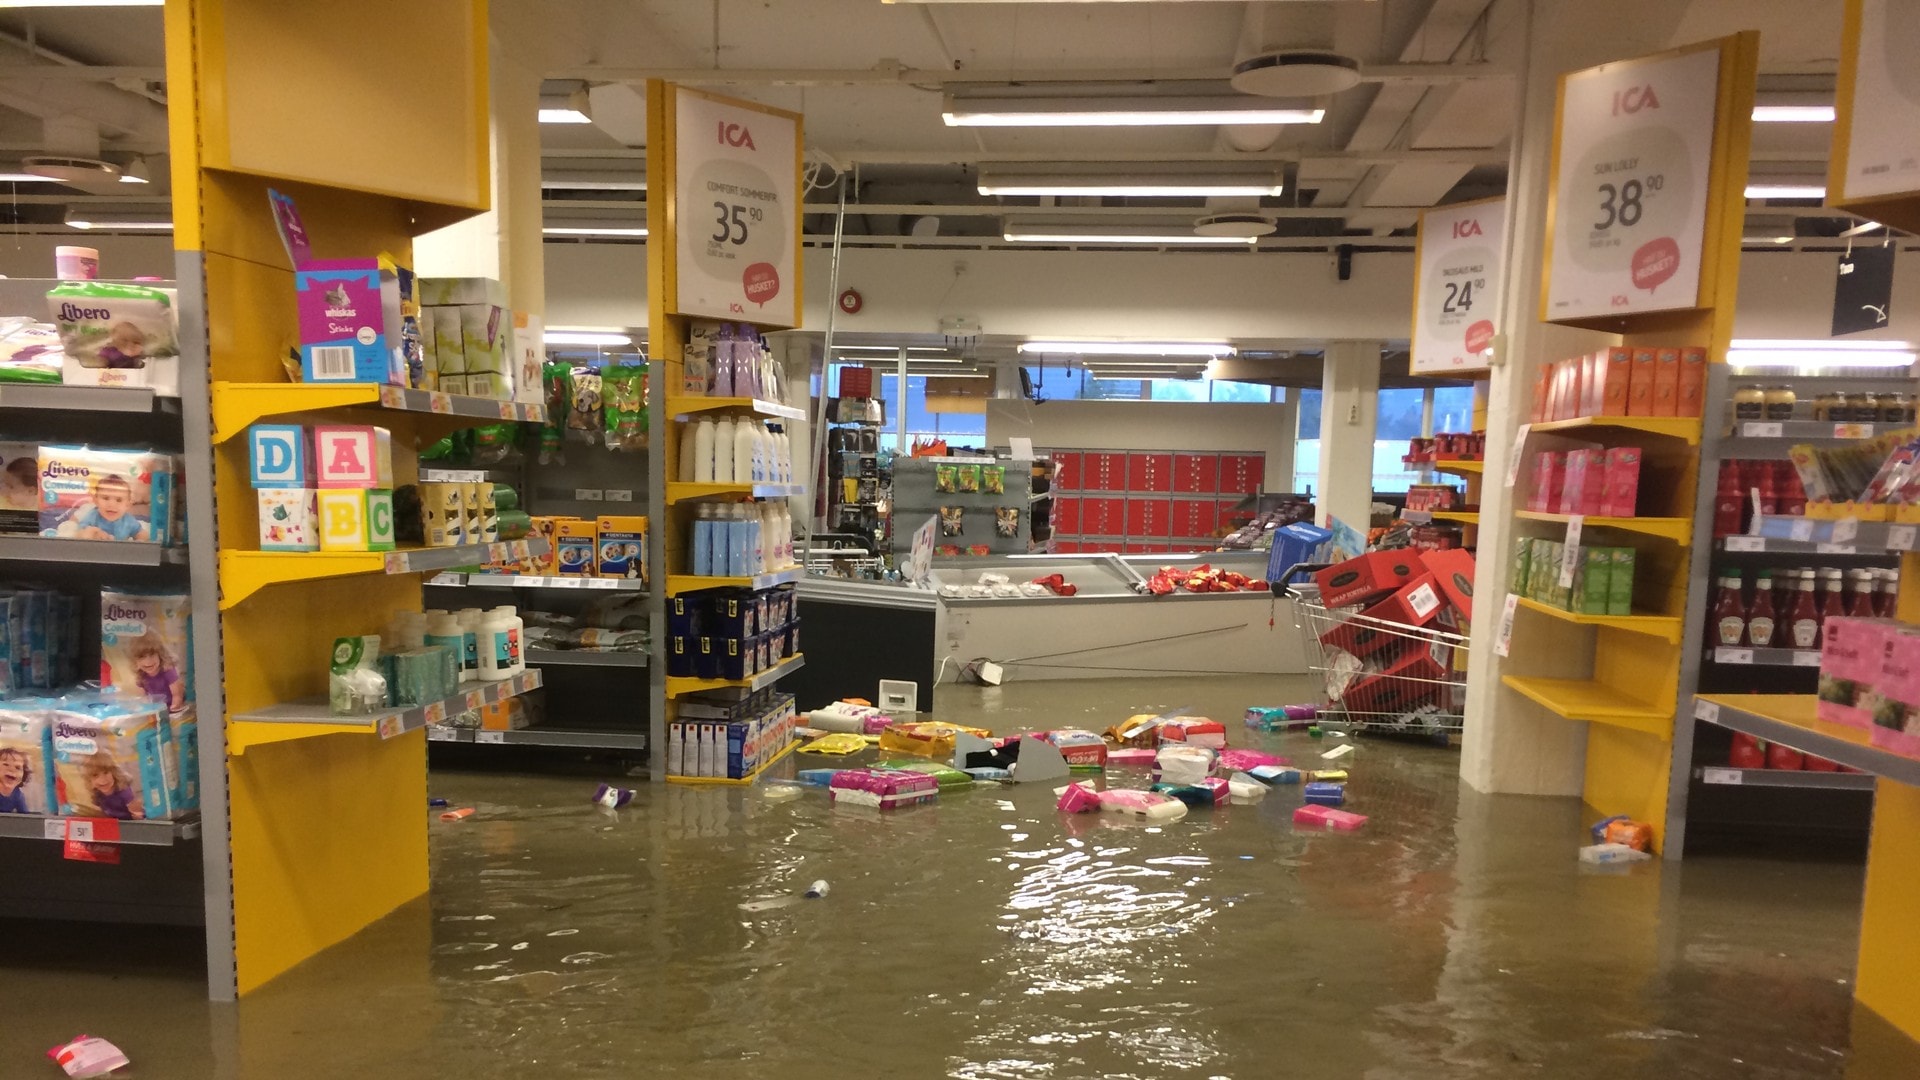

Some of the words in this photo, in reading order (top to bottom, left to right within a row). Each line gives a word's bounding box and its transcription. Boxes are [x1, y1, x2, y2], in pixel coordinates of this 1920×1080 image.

[1612, 83, 1660, 117] ICA
[718, 121, 756, 151] ICA
[1594, 159, 1614, 176] SUN
[1615, 157, 1640, 173] LOLLY
[707, 180, 738, 197] COMFORT
[1646, 174, 1664, 191] 90
[1594, 179, 1643, 230] 38
[712, 201, 748, 245] 35
[750, 207, 763, 222] 90
[1453, 219, 1483, 239] ICA
[747, 279, 775, 294] HUSKET?
[1474, 278, 1485, 290] 90
[1443, 280, 1473, 313] 24
[1611, 295, 1629, 306] ICA
[57, 302, 111, 322] Libero
[324, 305, 357, 318] whiskas
[730, 303, 744, 314] ICA
[1453, 356, 1464, 365] ICA
[259, 437, 292, 474] D
[328, 438, 365, 474] A
[42, 460, 90, 479] Libero
[326, 502, 357, 537] B
[373, 501, 390, 537] C
[104, 604, 146, 621] Libero
[104, 623, 142, 633] Comfort
[55, 722, 97, 739] Libero
